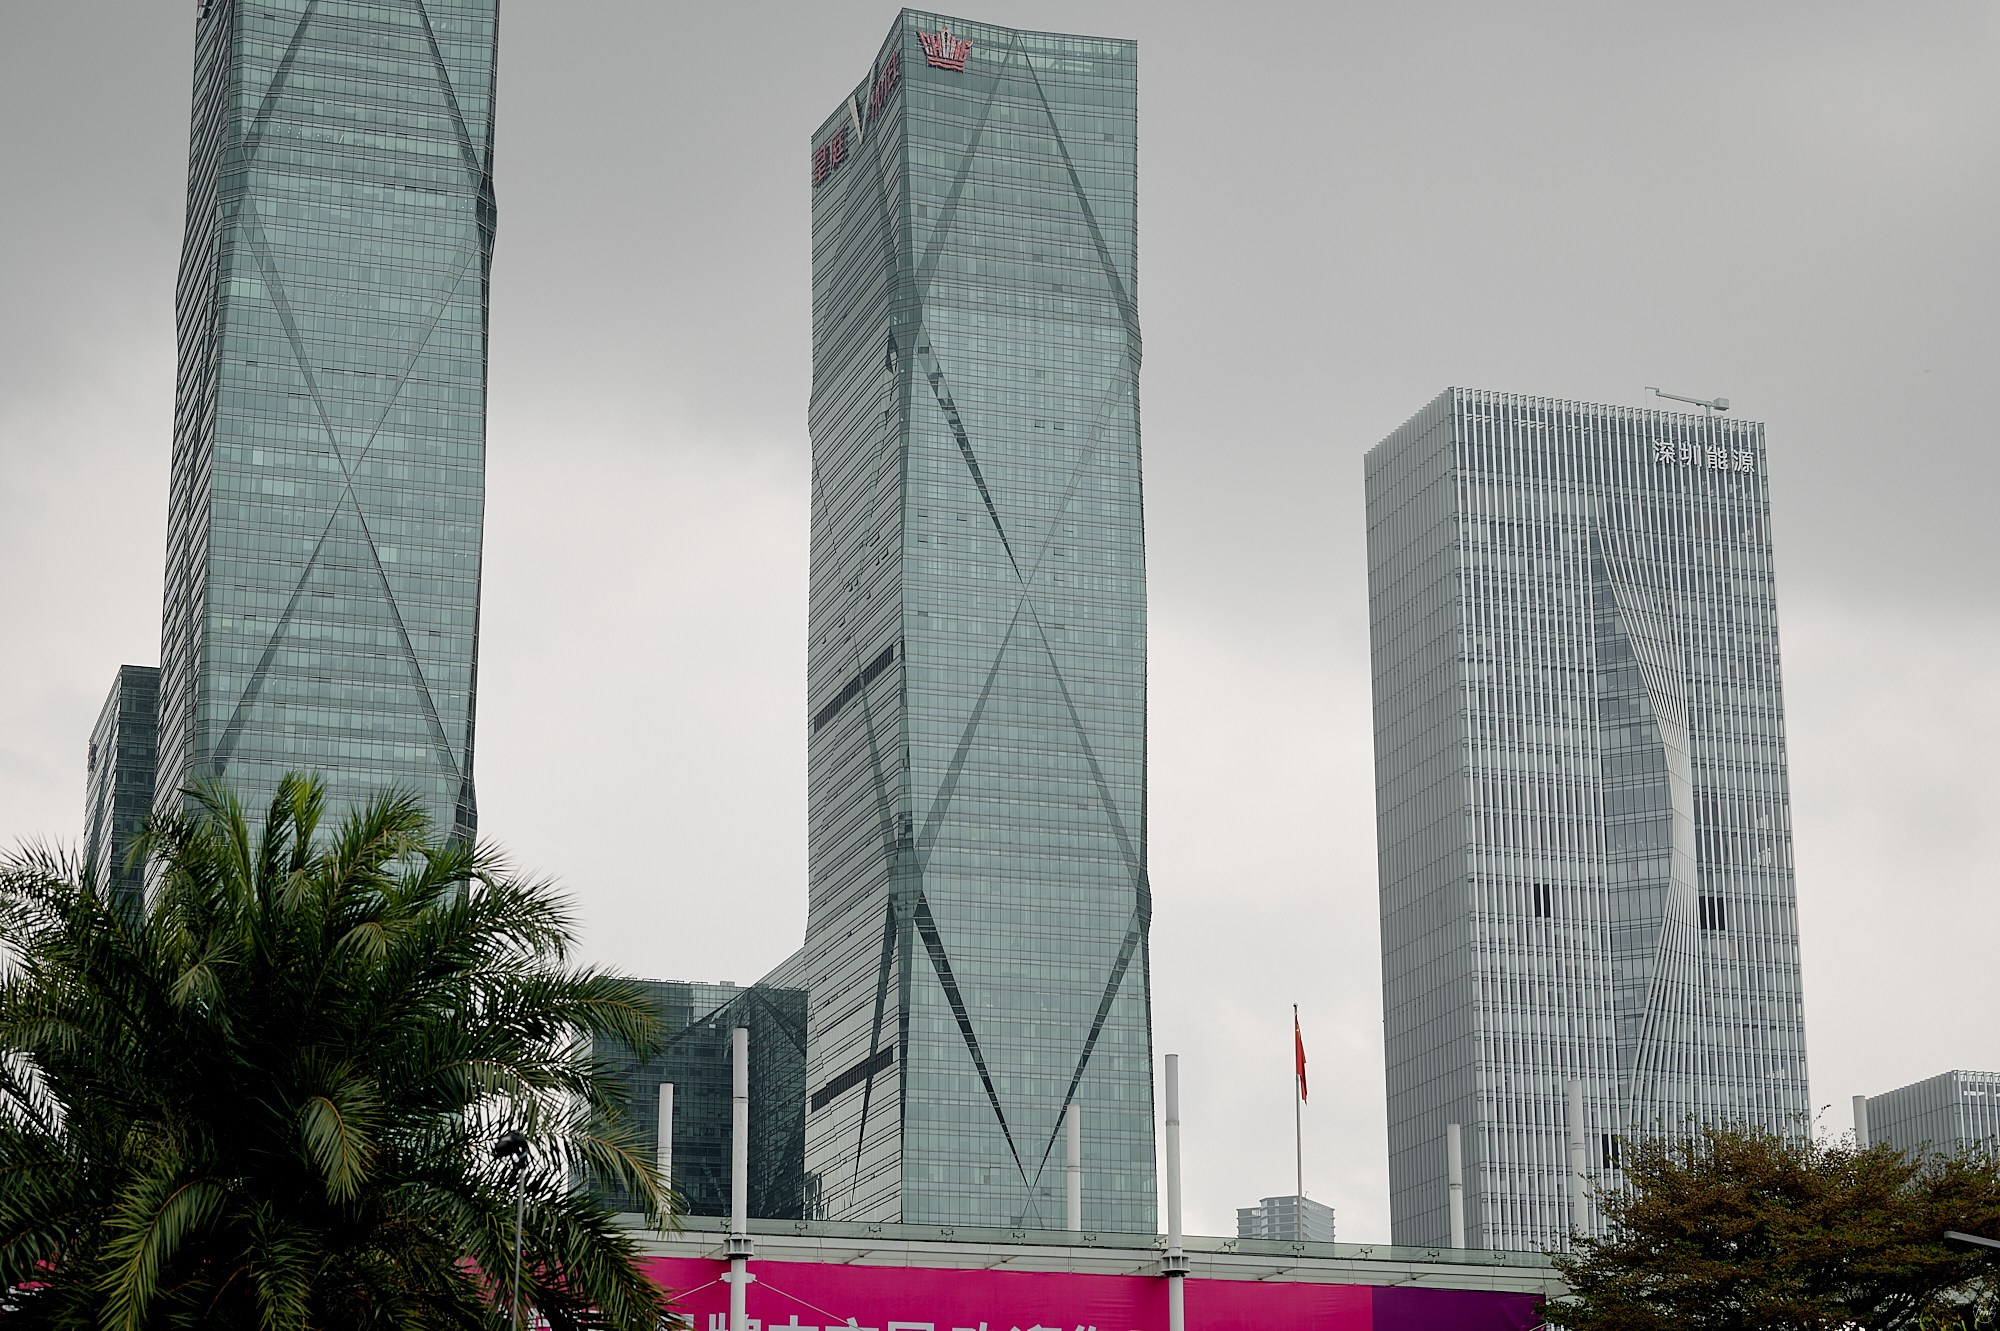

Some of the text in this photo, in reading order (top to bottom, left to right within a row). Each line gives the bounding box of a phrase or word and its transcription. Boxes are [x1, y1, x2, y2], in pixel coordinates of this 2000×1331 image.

[812, 51, 900, 187] 皇庭 V HOTEL
[1652, 438, 1755, 473] 深圳能源
